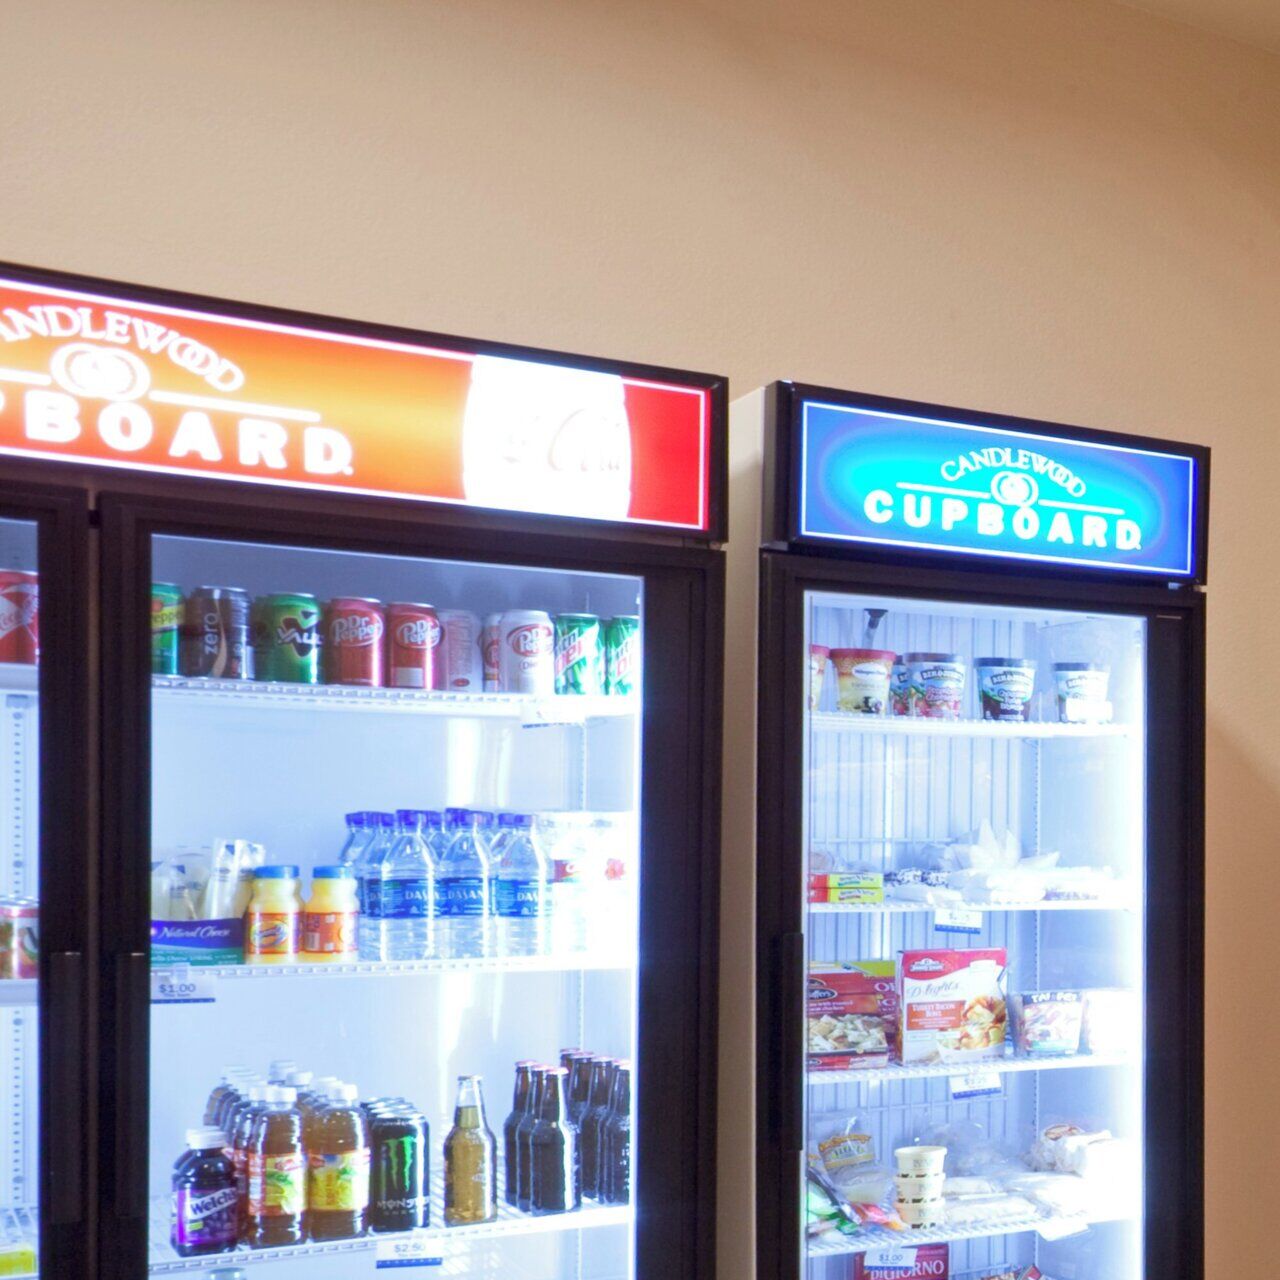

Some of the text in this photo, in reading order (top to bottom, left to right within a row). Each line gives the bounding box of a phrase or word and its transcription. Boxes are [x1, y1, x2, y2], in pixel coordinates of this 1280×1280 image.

[0, 305, 245, 393] ANDLEWOOD
[940, 447, 1086, 498] CANDLEWOOD
[863, 490, 1143, 550] CUPBOARD
[158, 983, 197, 994] $1.00
